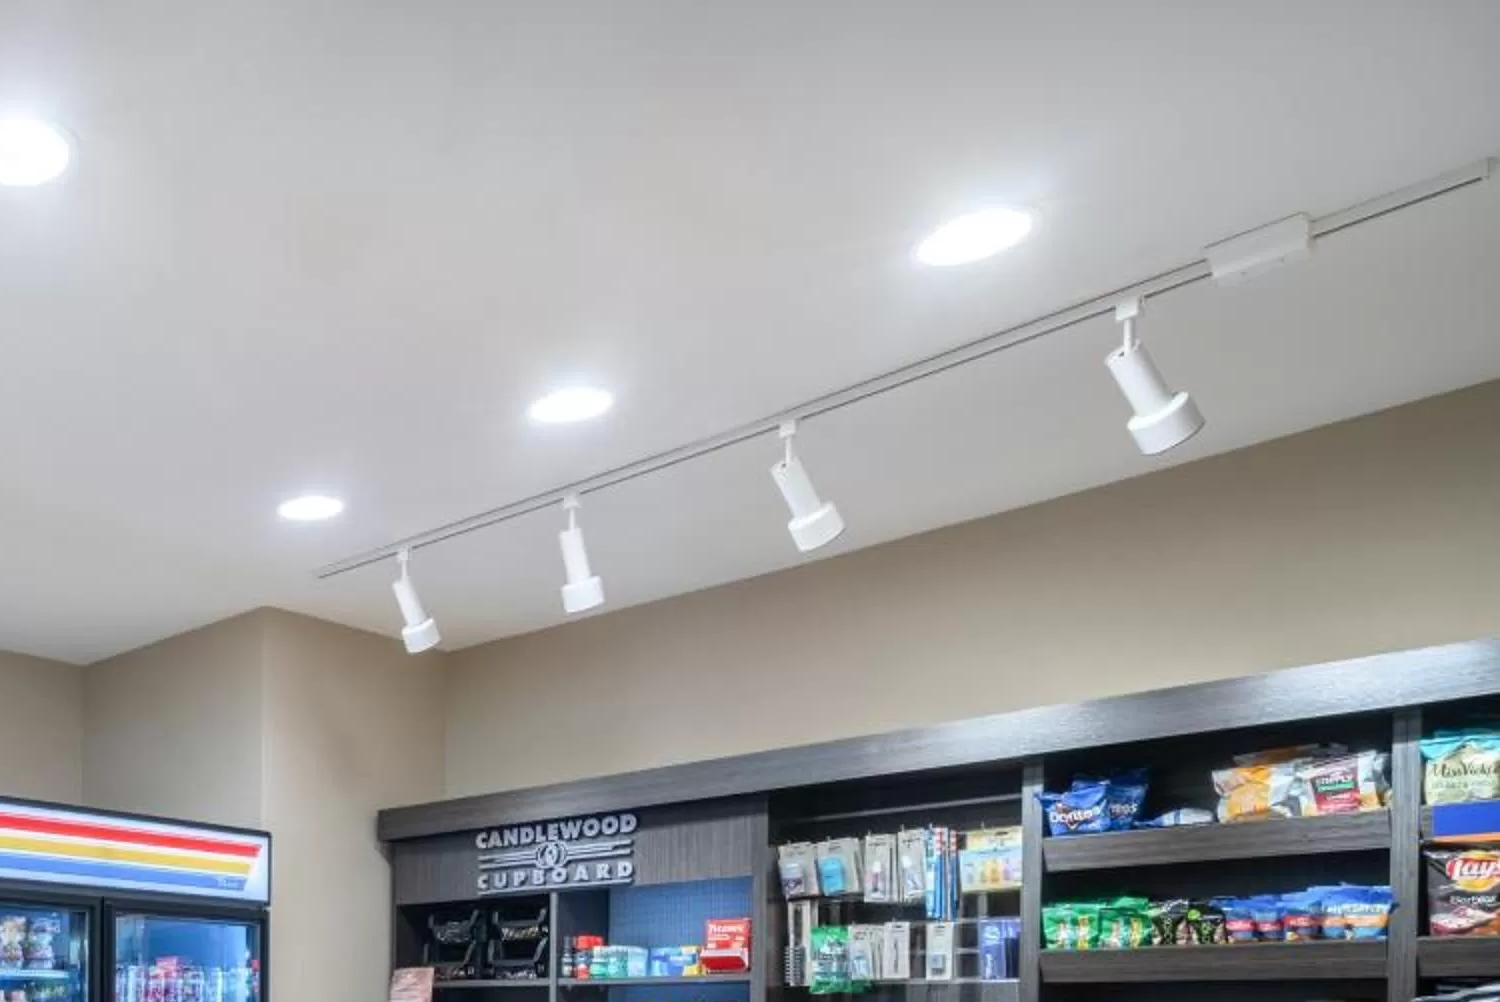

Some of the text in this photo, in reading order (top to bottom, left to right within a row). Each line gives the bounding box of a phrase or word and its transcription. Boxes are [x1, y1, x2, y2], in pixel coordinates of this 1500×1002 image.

[475, 813, 637, 849] CANDLEWOOD
[1050, 807, 1101, 825] Doritos
[477, 860, 634, 890] CUPBOARD
